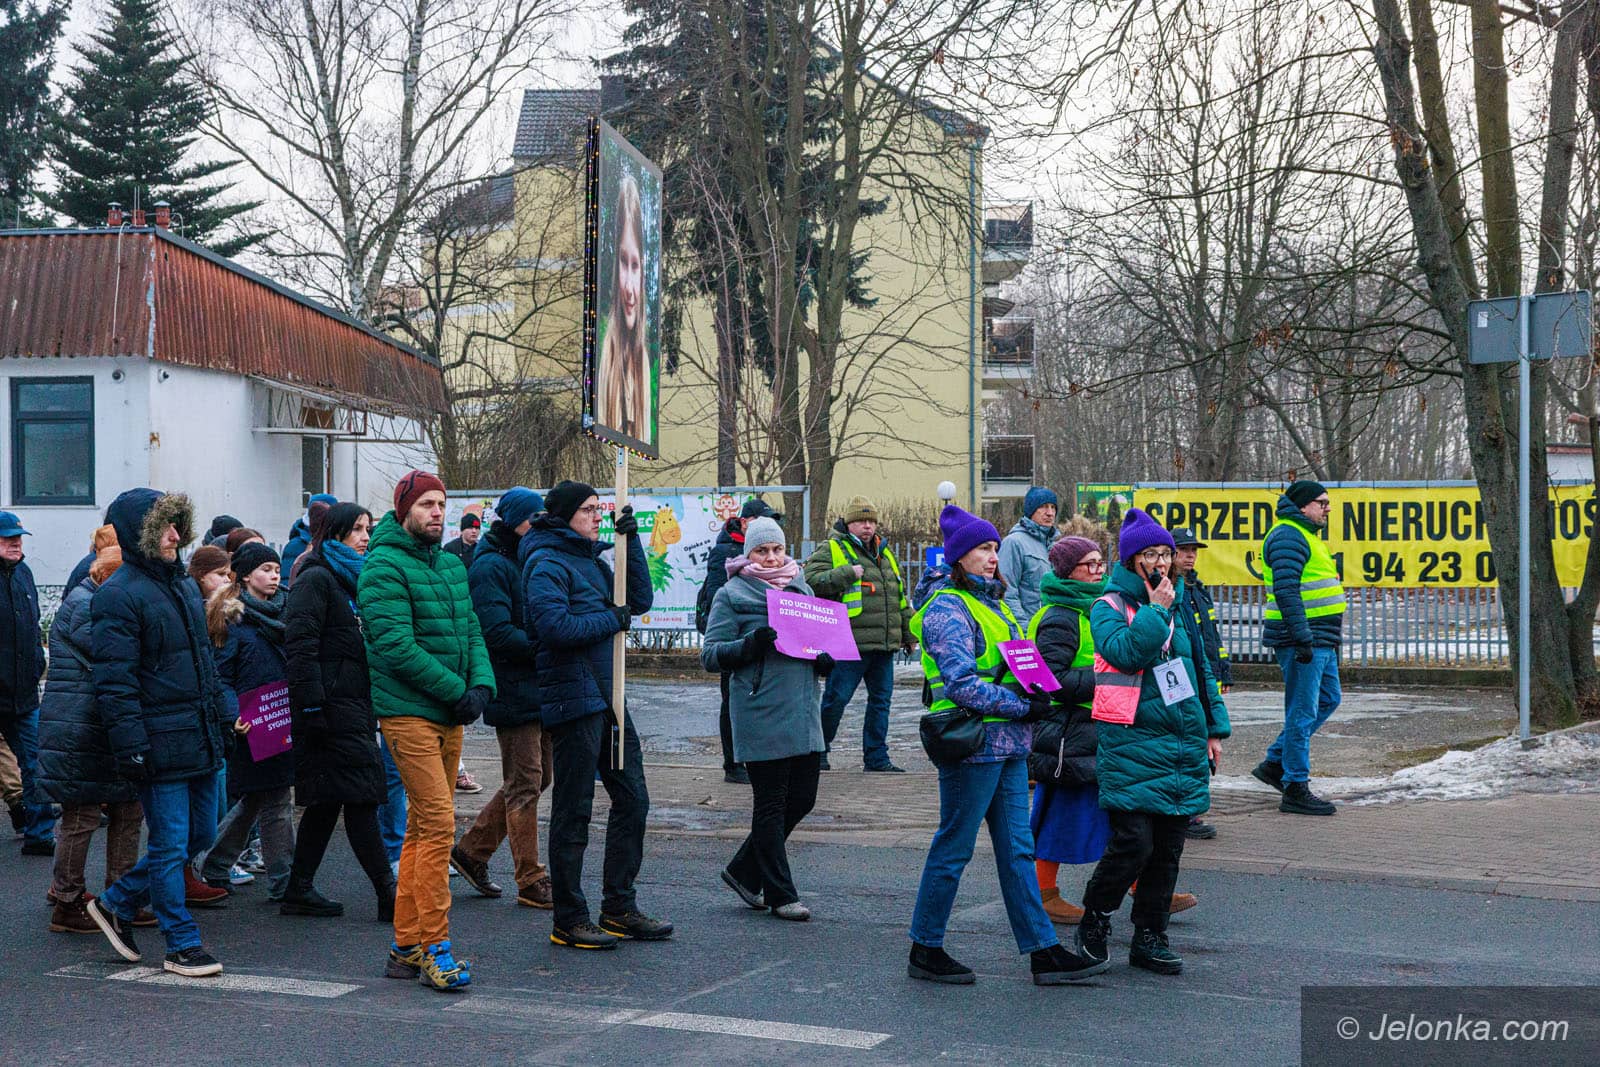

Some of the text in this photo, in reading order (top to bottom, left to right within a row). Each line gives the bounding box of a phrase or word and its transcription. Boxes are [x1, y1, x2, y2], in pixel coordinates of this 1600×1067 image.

[1145, 502, 1329, 540] SPRZED
[689, 552, 698, 566] 1
[1363, 552, 1405, 582] 94
[1418, 552, 1461, 582] 23
[1476, 552, 1498, 582] 0
[779, 598, 834, 615] KTO UCZY NASZE
[779, 608, 801, 617] DZIECI
[260, 687, 289, 702] REAGUJ
[258, 705, 270, 713] NA
[251, 715, 264, 726] NIE
